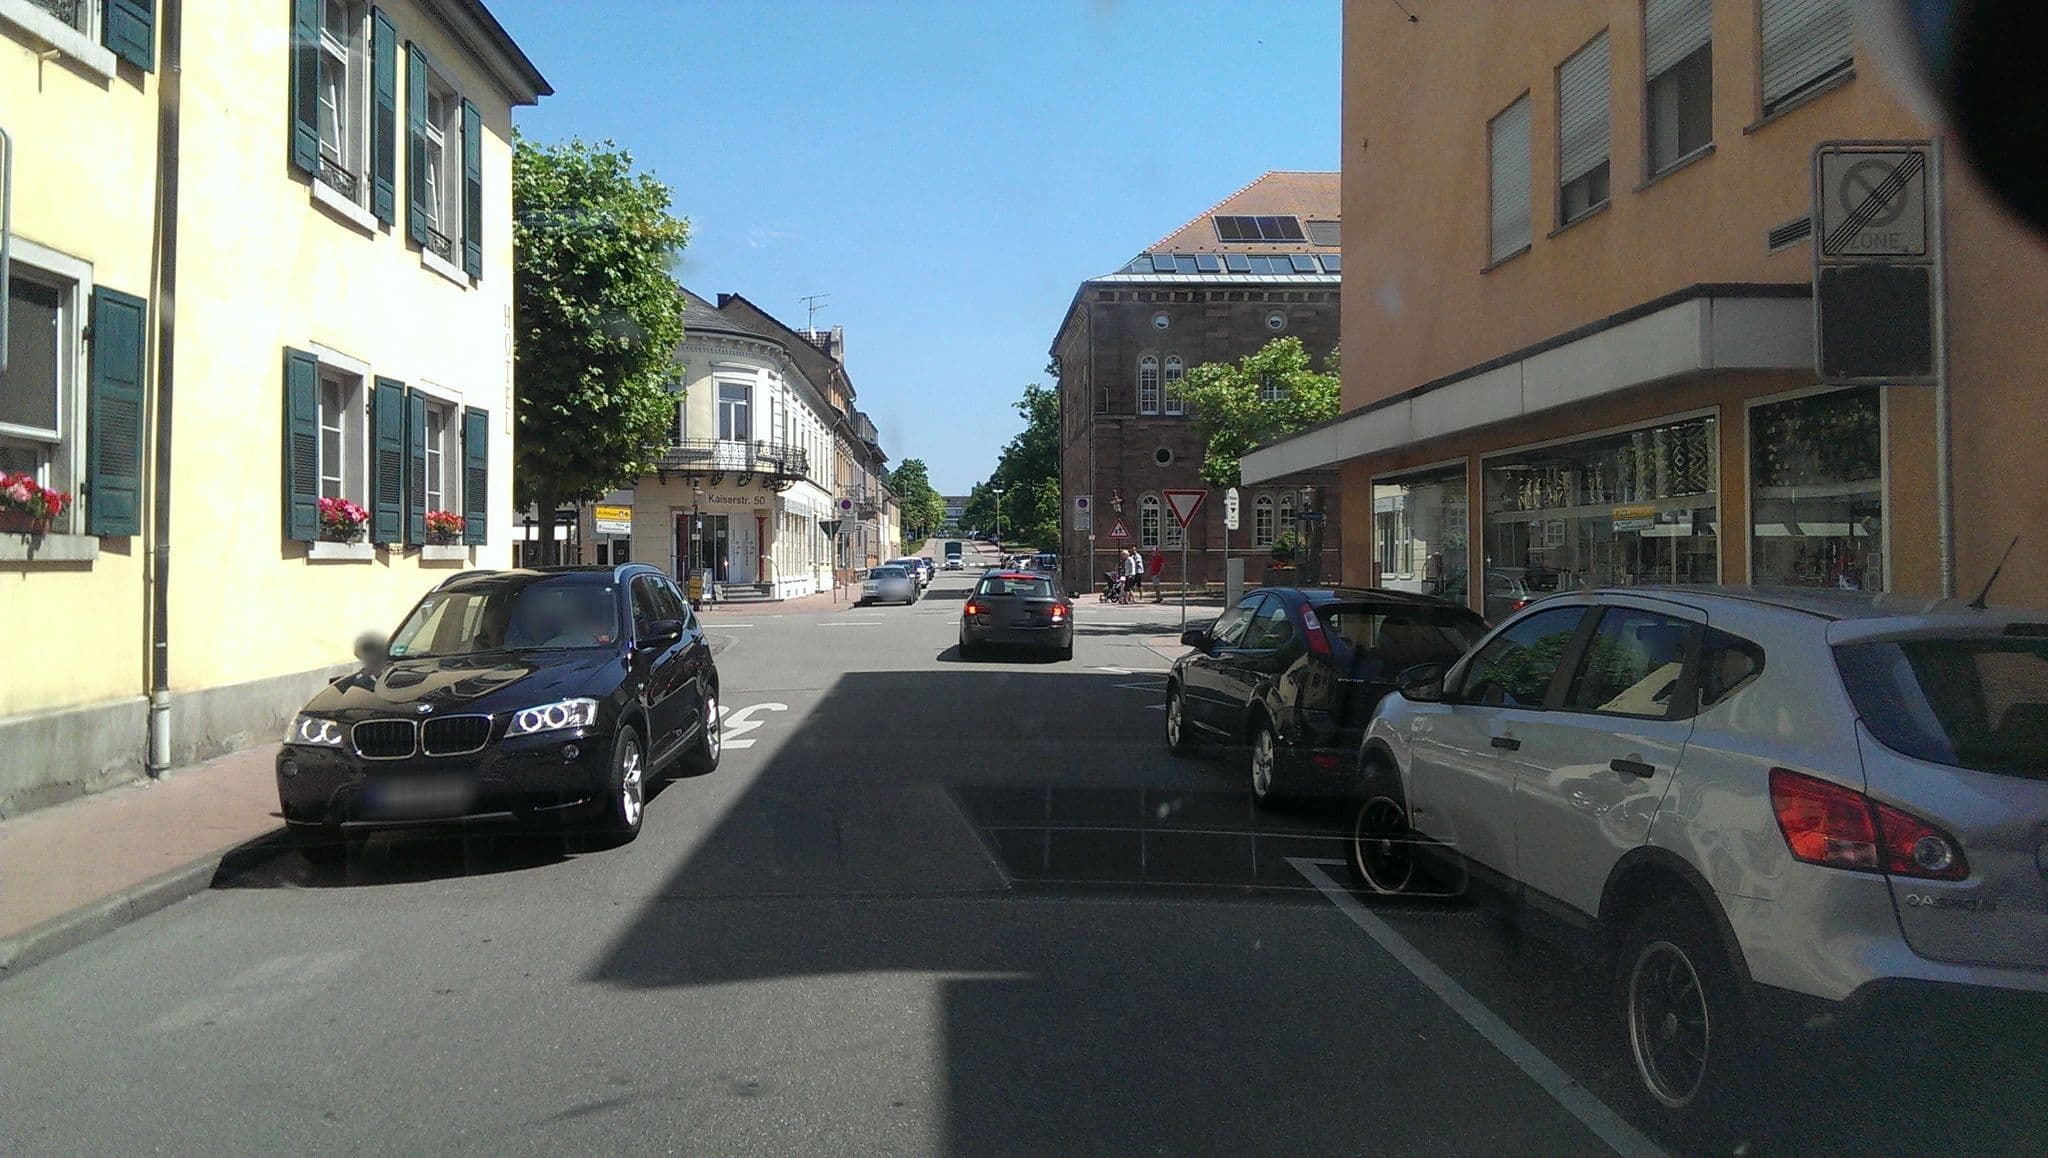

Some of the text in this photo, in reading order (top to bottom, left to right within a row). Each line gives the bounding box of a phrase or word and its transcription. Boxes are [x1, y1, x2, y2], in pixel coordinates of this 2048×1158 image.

[503, 303, 512, 436] HOTEL
[708, 493, 766, 506] Kaiserstr. 50
